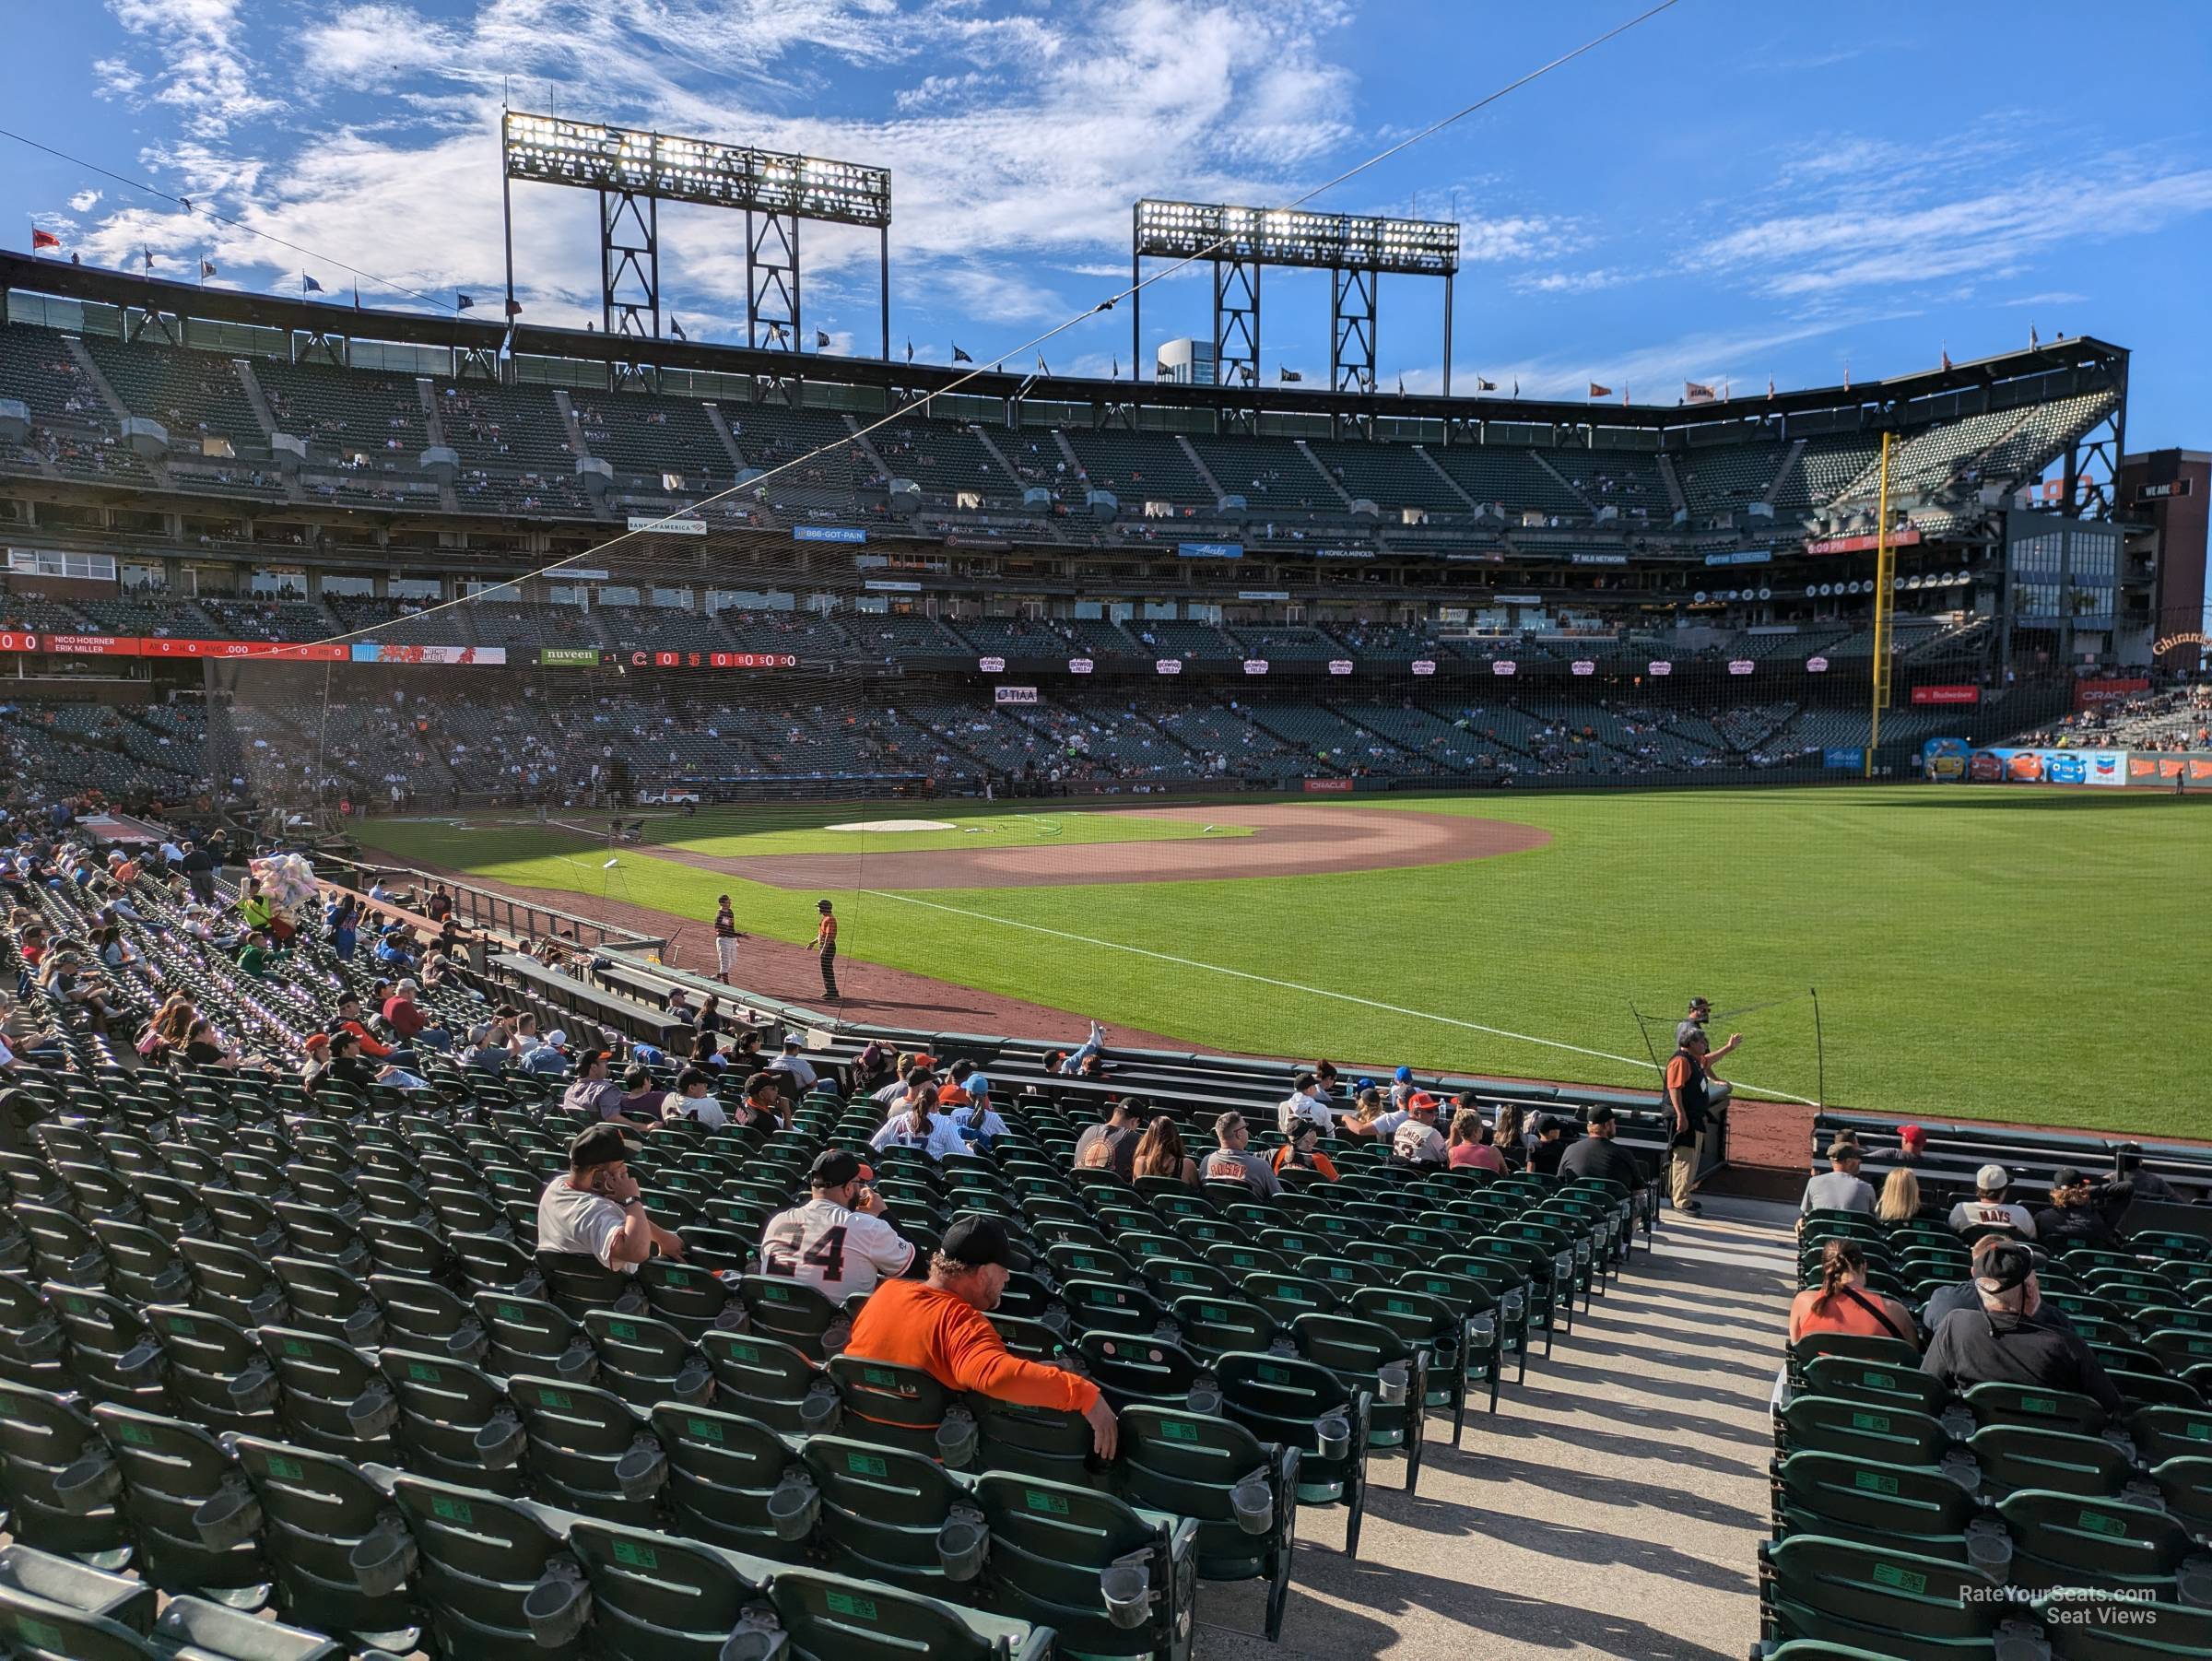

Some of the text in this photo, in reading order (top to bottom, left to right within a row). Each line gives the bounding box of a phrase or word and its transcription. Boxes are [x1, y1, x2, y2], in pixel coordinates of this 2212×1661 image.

[2146, 487, 2156, 497] WE
[2157, 486, 2171, 496] ARE
[1195, 545, 1227, 555] Alaska
[2, 634, 36, 650] 0 0
[76, 637, 114, 645] HOERNER
[75, 645, 103, 654] MILLER
[162, 643, 170, 652] 0
[188, 644, 195, 653] 0
[226, 645, 248, 654] .000
[300, 647, 308, 655] 0
[335, 648, 341, 656] 0
[547, 650, 593, 659] nuveen
[663, 654, 672, 665] 0
[717, 654, 726, 666] 0
[1009, 690, 1035, 701] TIAA
[1933, 689, 1972, 699] Budweiser
[1979, 1210, 2011, 1224] MAYS
[765, 1222, 848, 1282] 24
